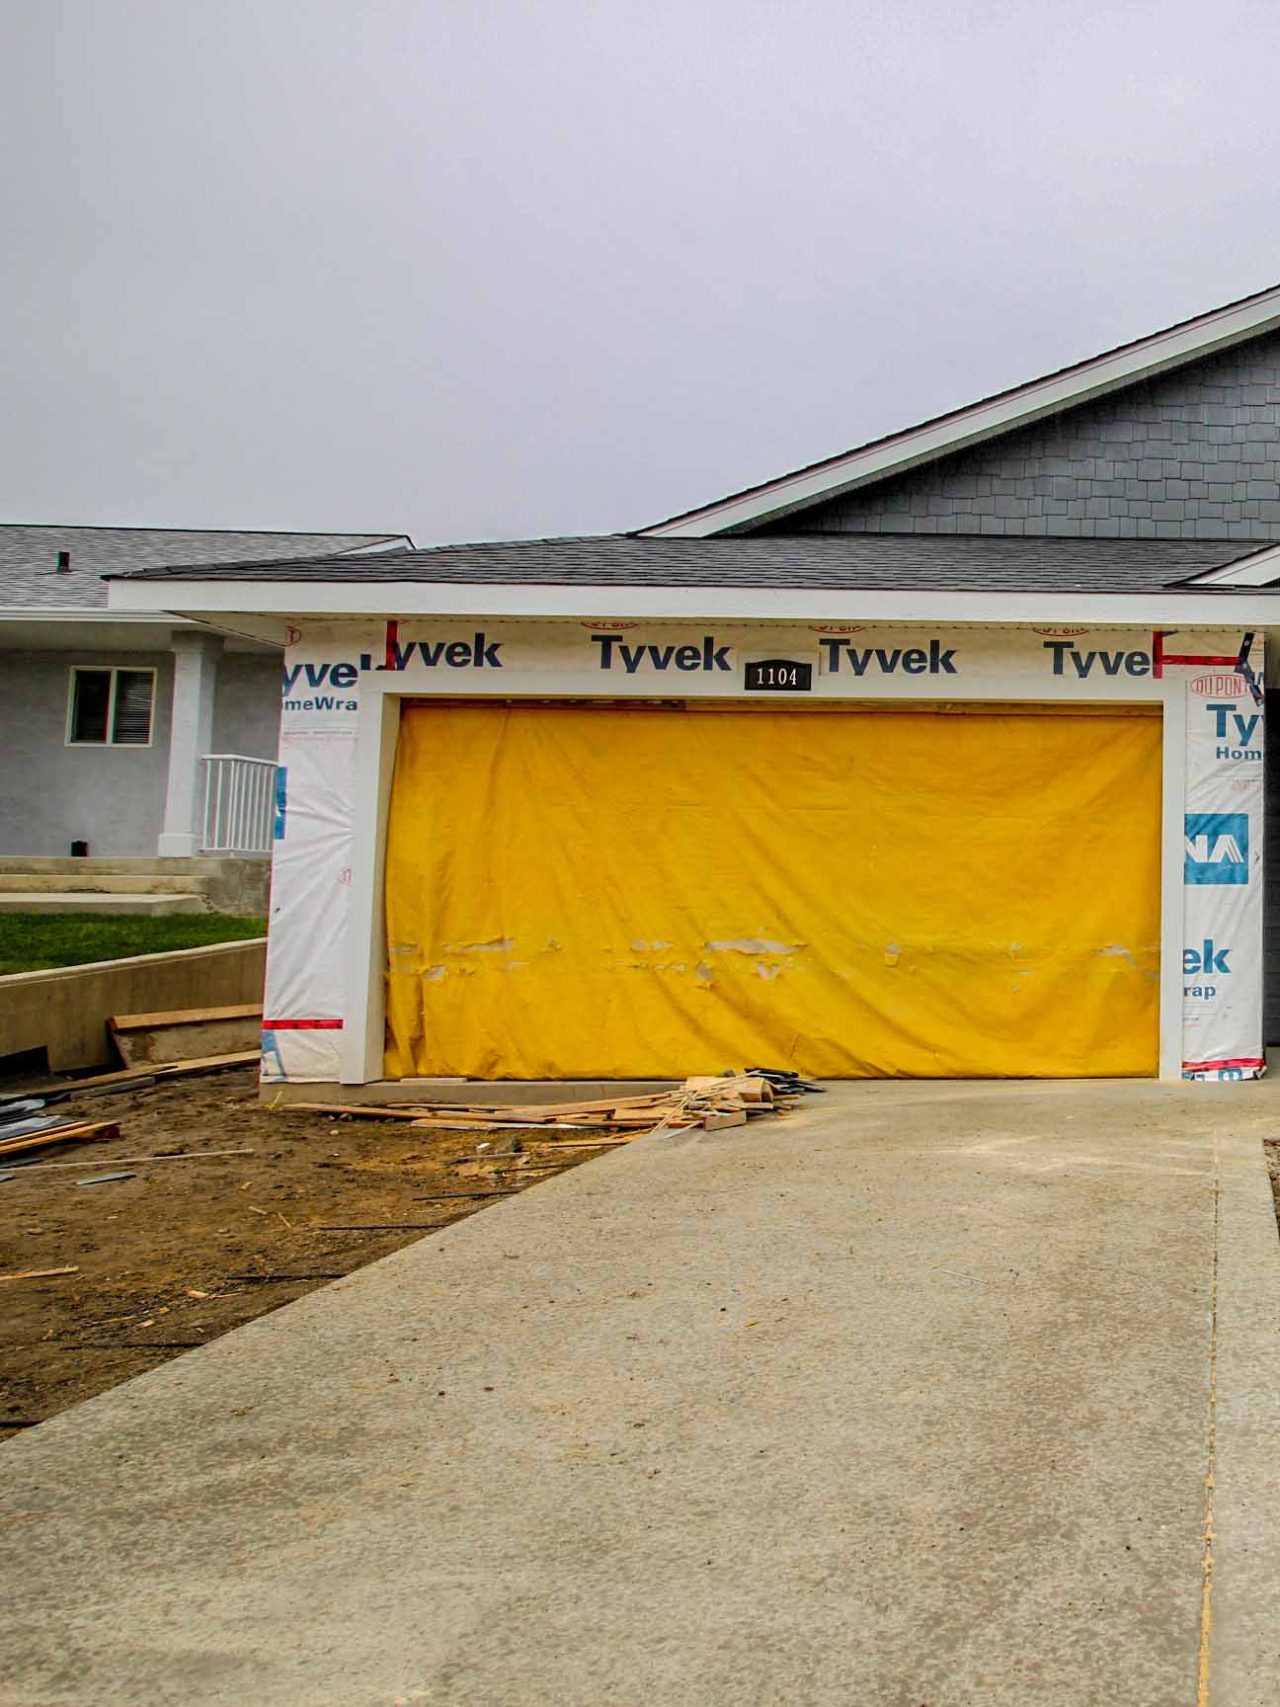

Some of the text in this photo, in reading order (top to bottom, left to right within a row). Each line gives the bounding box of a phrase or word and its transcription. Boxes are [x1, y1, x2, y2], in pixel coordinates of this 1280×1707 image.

[591, 635, 733, 673] Tyvek
[819, 639, 958, 676] Tyvek
[757, 668, 797, 685] 1104
[1206, 704, 1264, 746] Ty
